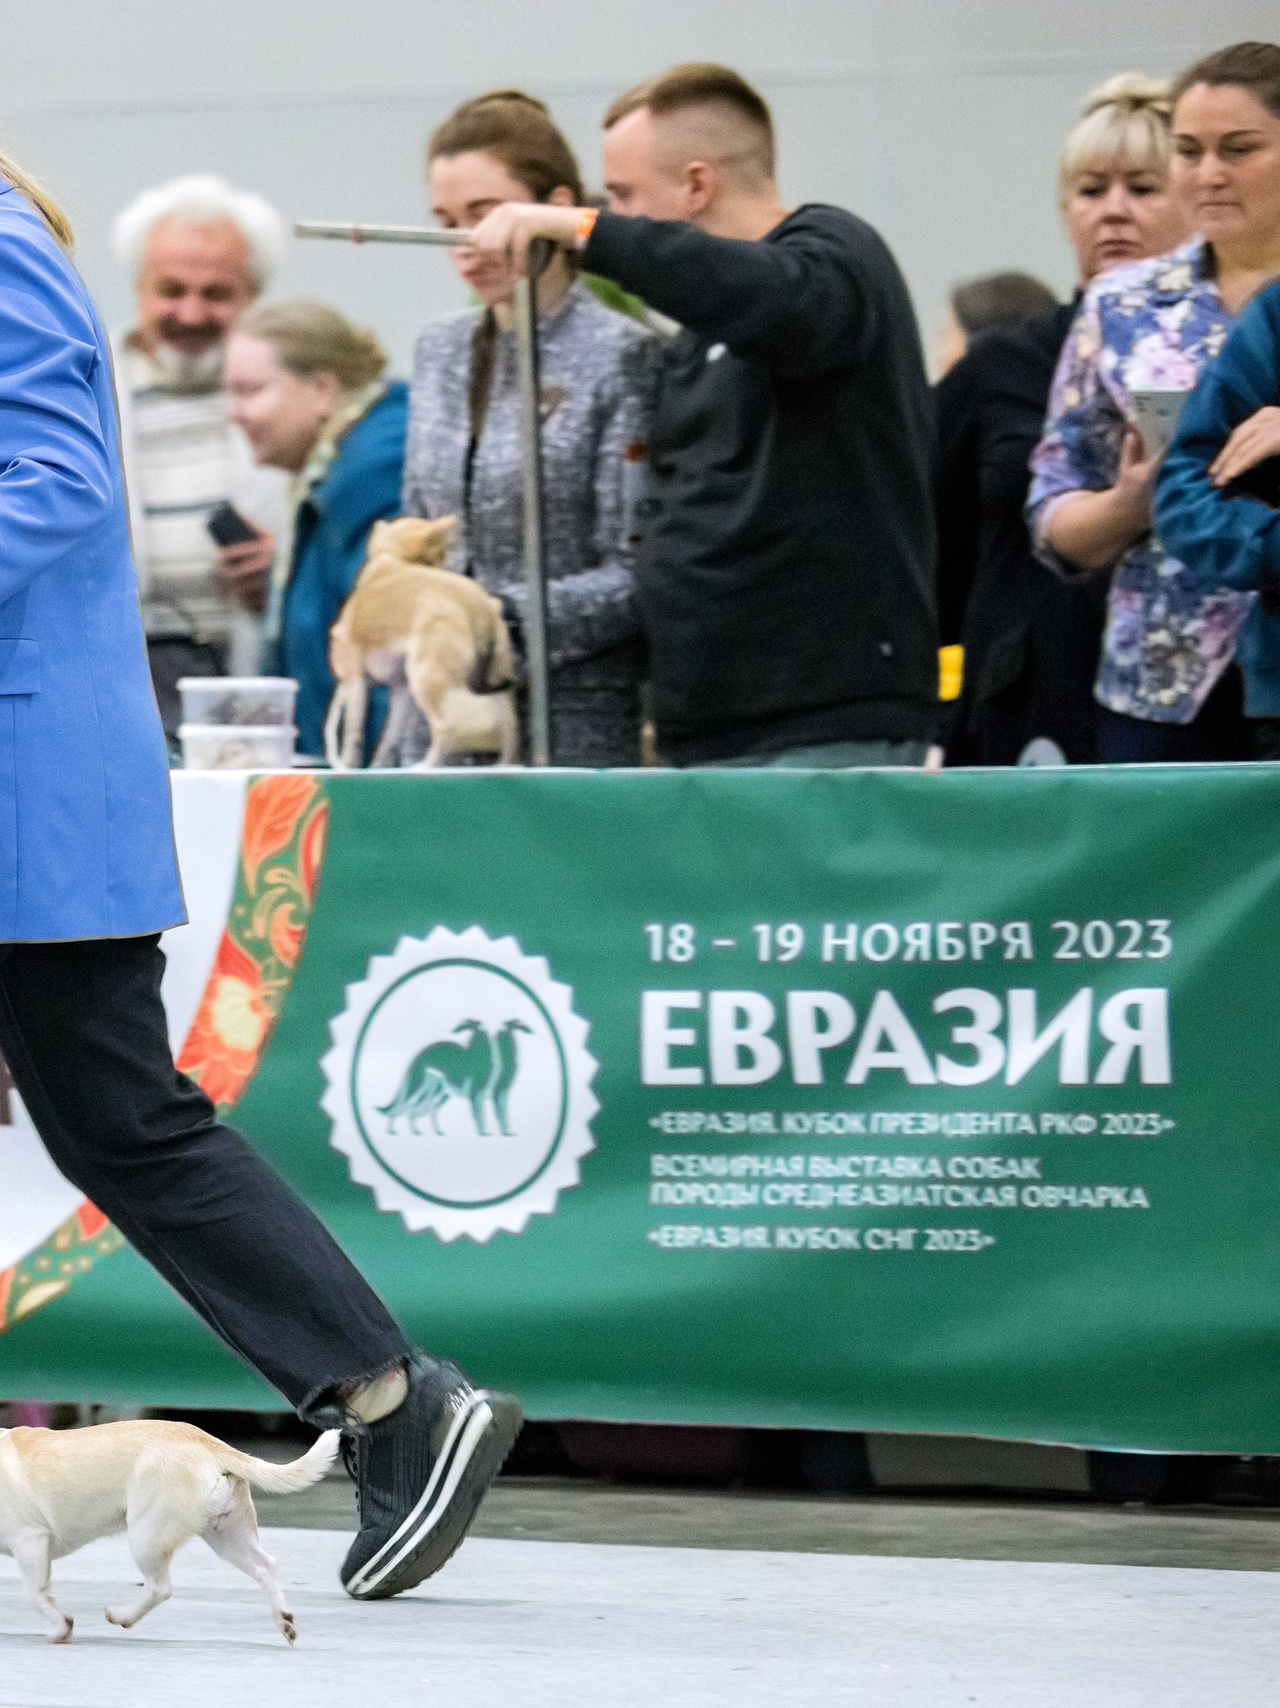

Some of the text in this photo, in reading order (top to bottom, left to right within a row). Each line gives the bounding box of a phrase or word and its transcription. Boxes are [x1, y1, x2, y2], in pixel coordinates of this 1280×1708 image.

[644, 922, 696, 963] 18
[752, 921, 806, 963] 19
[821, 920, 1034, 962] НОЯБРЯ
[1052, 919, 1174, 960] 2023
[639, 987, 1173, 1086] ЕВРАЗИЯ
[1039, 1112, 1098, 1135] РКФ
[946, 1155, 1043, 1179] СОБАК
[864, 1227, 918, 1251] СНГ
